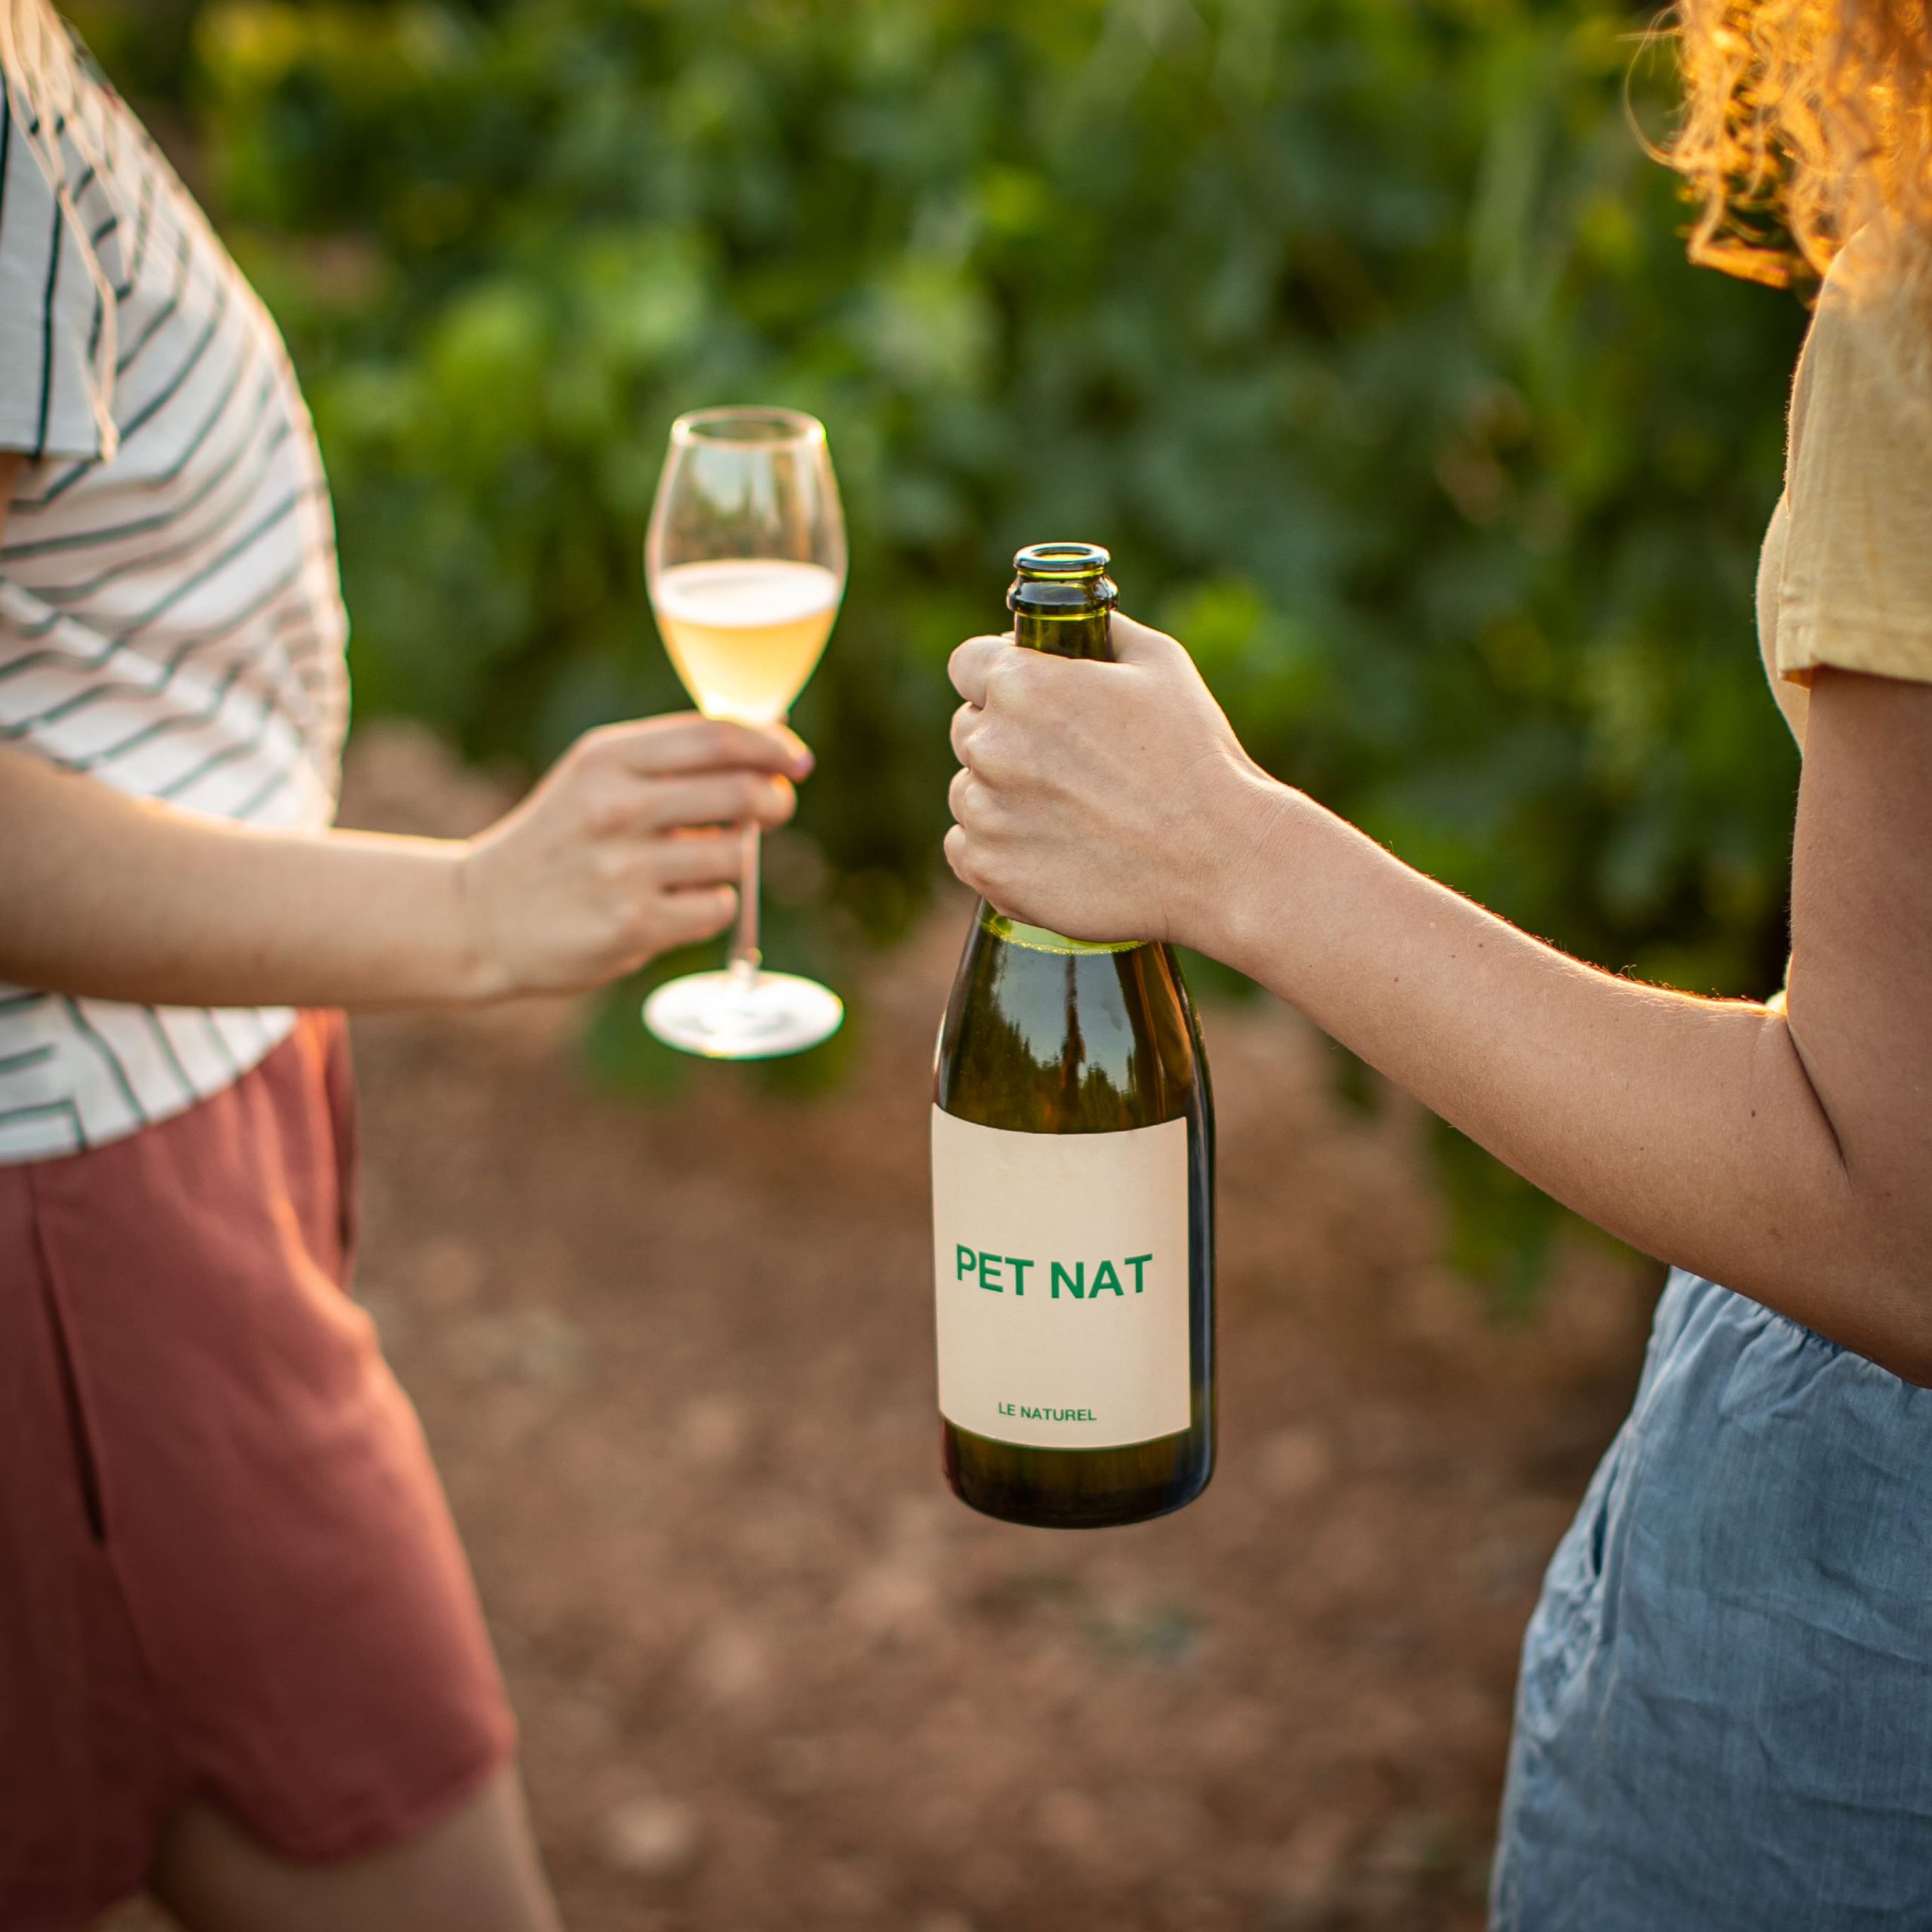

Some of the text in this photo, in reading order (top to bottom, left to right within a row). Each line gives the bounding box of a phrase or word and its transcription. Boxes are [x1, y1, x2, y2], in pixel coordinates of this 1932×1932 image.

[955, 1244, 1154, 1300] PET NAT
[998, 1401, 1097, 1423] LE NATUREL
